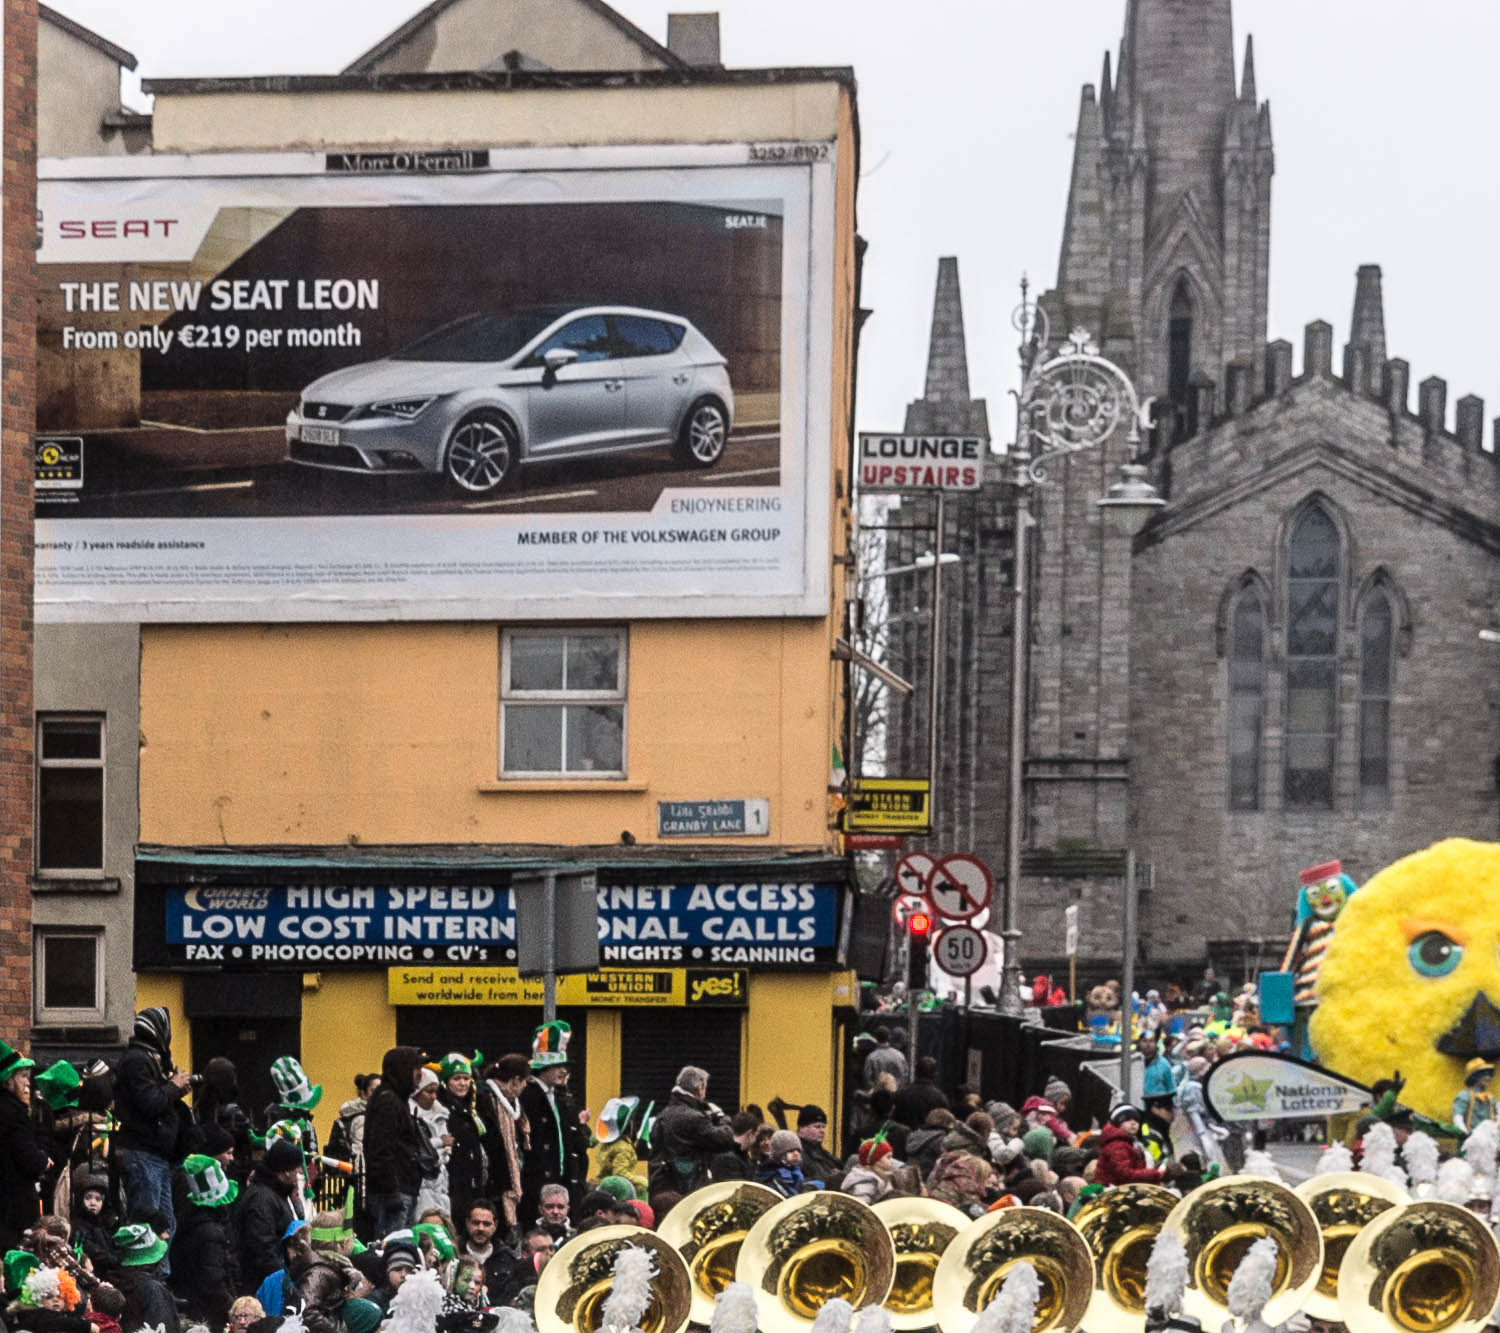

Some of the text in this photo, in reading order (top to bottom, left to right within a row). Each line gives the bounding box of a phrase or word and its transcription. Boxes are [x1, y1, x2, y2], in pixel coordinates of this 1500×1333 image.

[342, 153, 389, 171] More
[59, 219, 179, 240] SEAT
[60, 279, 379, 312] THE NEW SEAT LEON
[62, 322, 361, 354] From only €219 per month
[862, 438, 979, 459] LOUNGE
[862, 465, 977, 486] UPSTAIRS
[670, 498, 782, 515] ENJOYNEERING
[89, 540, 114, 551] years
[115, 538, 155, 549] roadside
[157, 539, 205, 549] assistance
[517, 527, 781, 546] MEMBER OF THE VOLKSWAGEN GROUP
[754, 808, 761, 824] 1
[663, 820, 708, 832] GRANBY
[208, 898, 269, 910] WORLD
[286, 886, 375, 909] HIGH
[389, 885, 495, 909] SPEED
[508, 884, 677, 910] IRNET
[686, 884, 816, 911] ACCESS
[182, 915, 266, 939] LOW
[278, 915, 372, 940] COST
[701, 916, 816, 941] CALLS
[185, 945, 816, 963] FAX PHOTOCOPYING CV's NIGHTS SCANNING
[947, 936, 975, 961] 50
[402, 972, 435, 985] Send
[439, 972, 464, 985] and
[469, 972, 517, 985] receive
[691, 972, 741, 1001] yes!
[416, 988, 545, 1001] worldwide from her
[608, 983, 654, 993] UNION
[1275, 1083, 1348, 1098] National
[1280, 1098, 1344, 1112] Lottery
